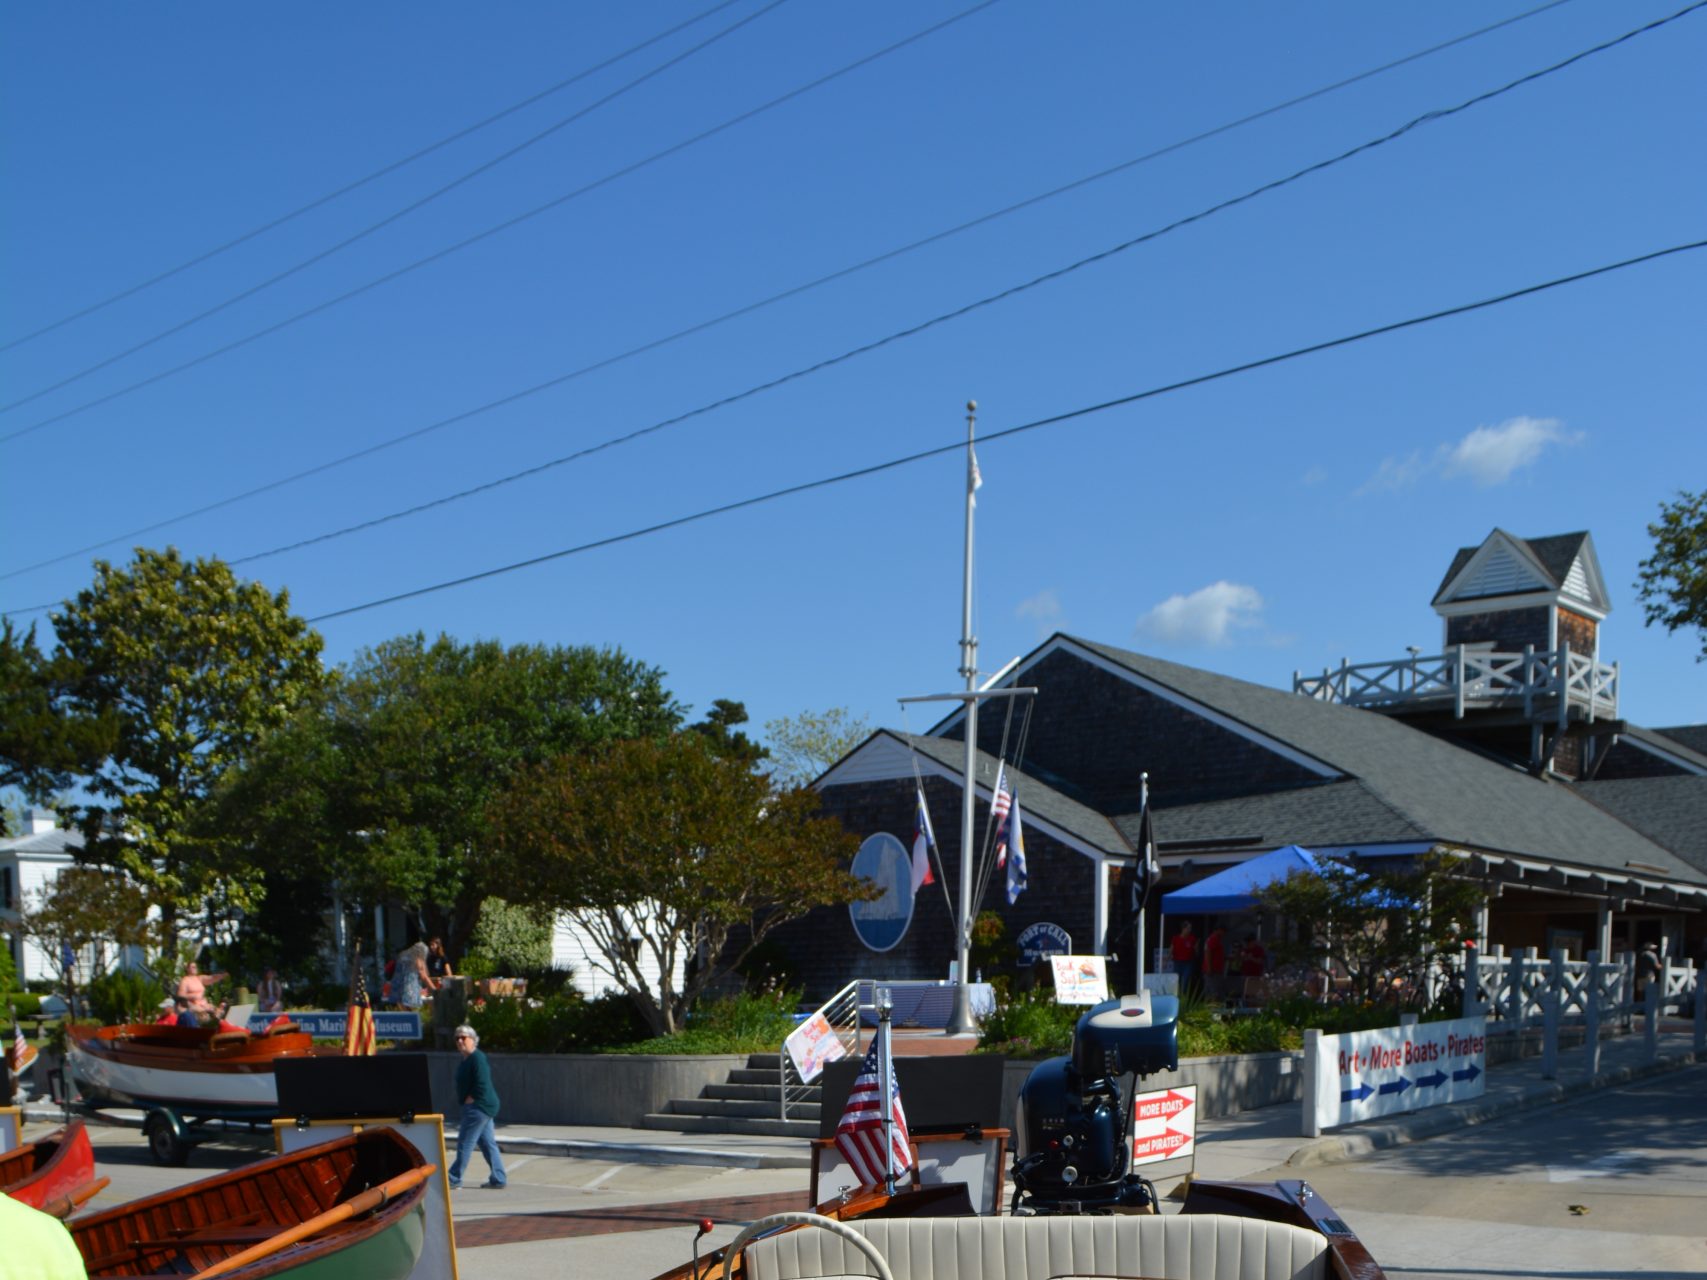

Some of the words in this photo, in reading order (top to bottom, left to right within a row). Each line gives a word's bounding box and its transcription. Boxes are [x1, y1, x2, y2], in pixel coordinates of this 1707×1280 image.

[1048, 926, 1067, 946] CALL
[1339, 1050, 1359, 1076] Art
[1370, 1044, 1401, 1070] More
[1404, 1040, 1438, 1065] Boats
[1447, 1033, 1484, 1058] Pirates
[1140, 1103, 1160, 1117] MORE
[1161, 1099, 1184, 1114] BOATS
[1137, 1142, 1151, 1154] and
[1151, 1134, 1184, 1151] PIRATES!!
